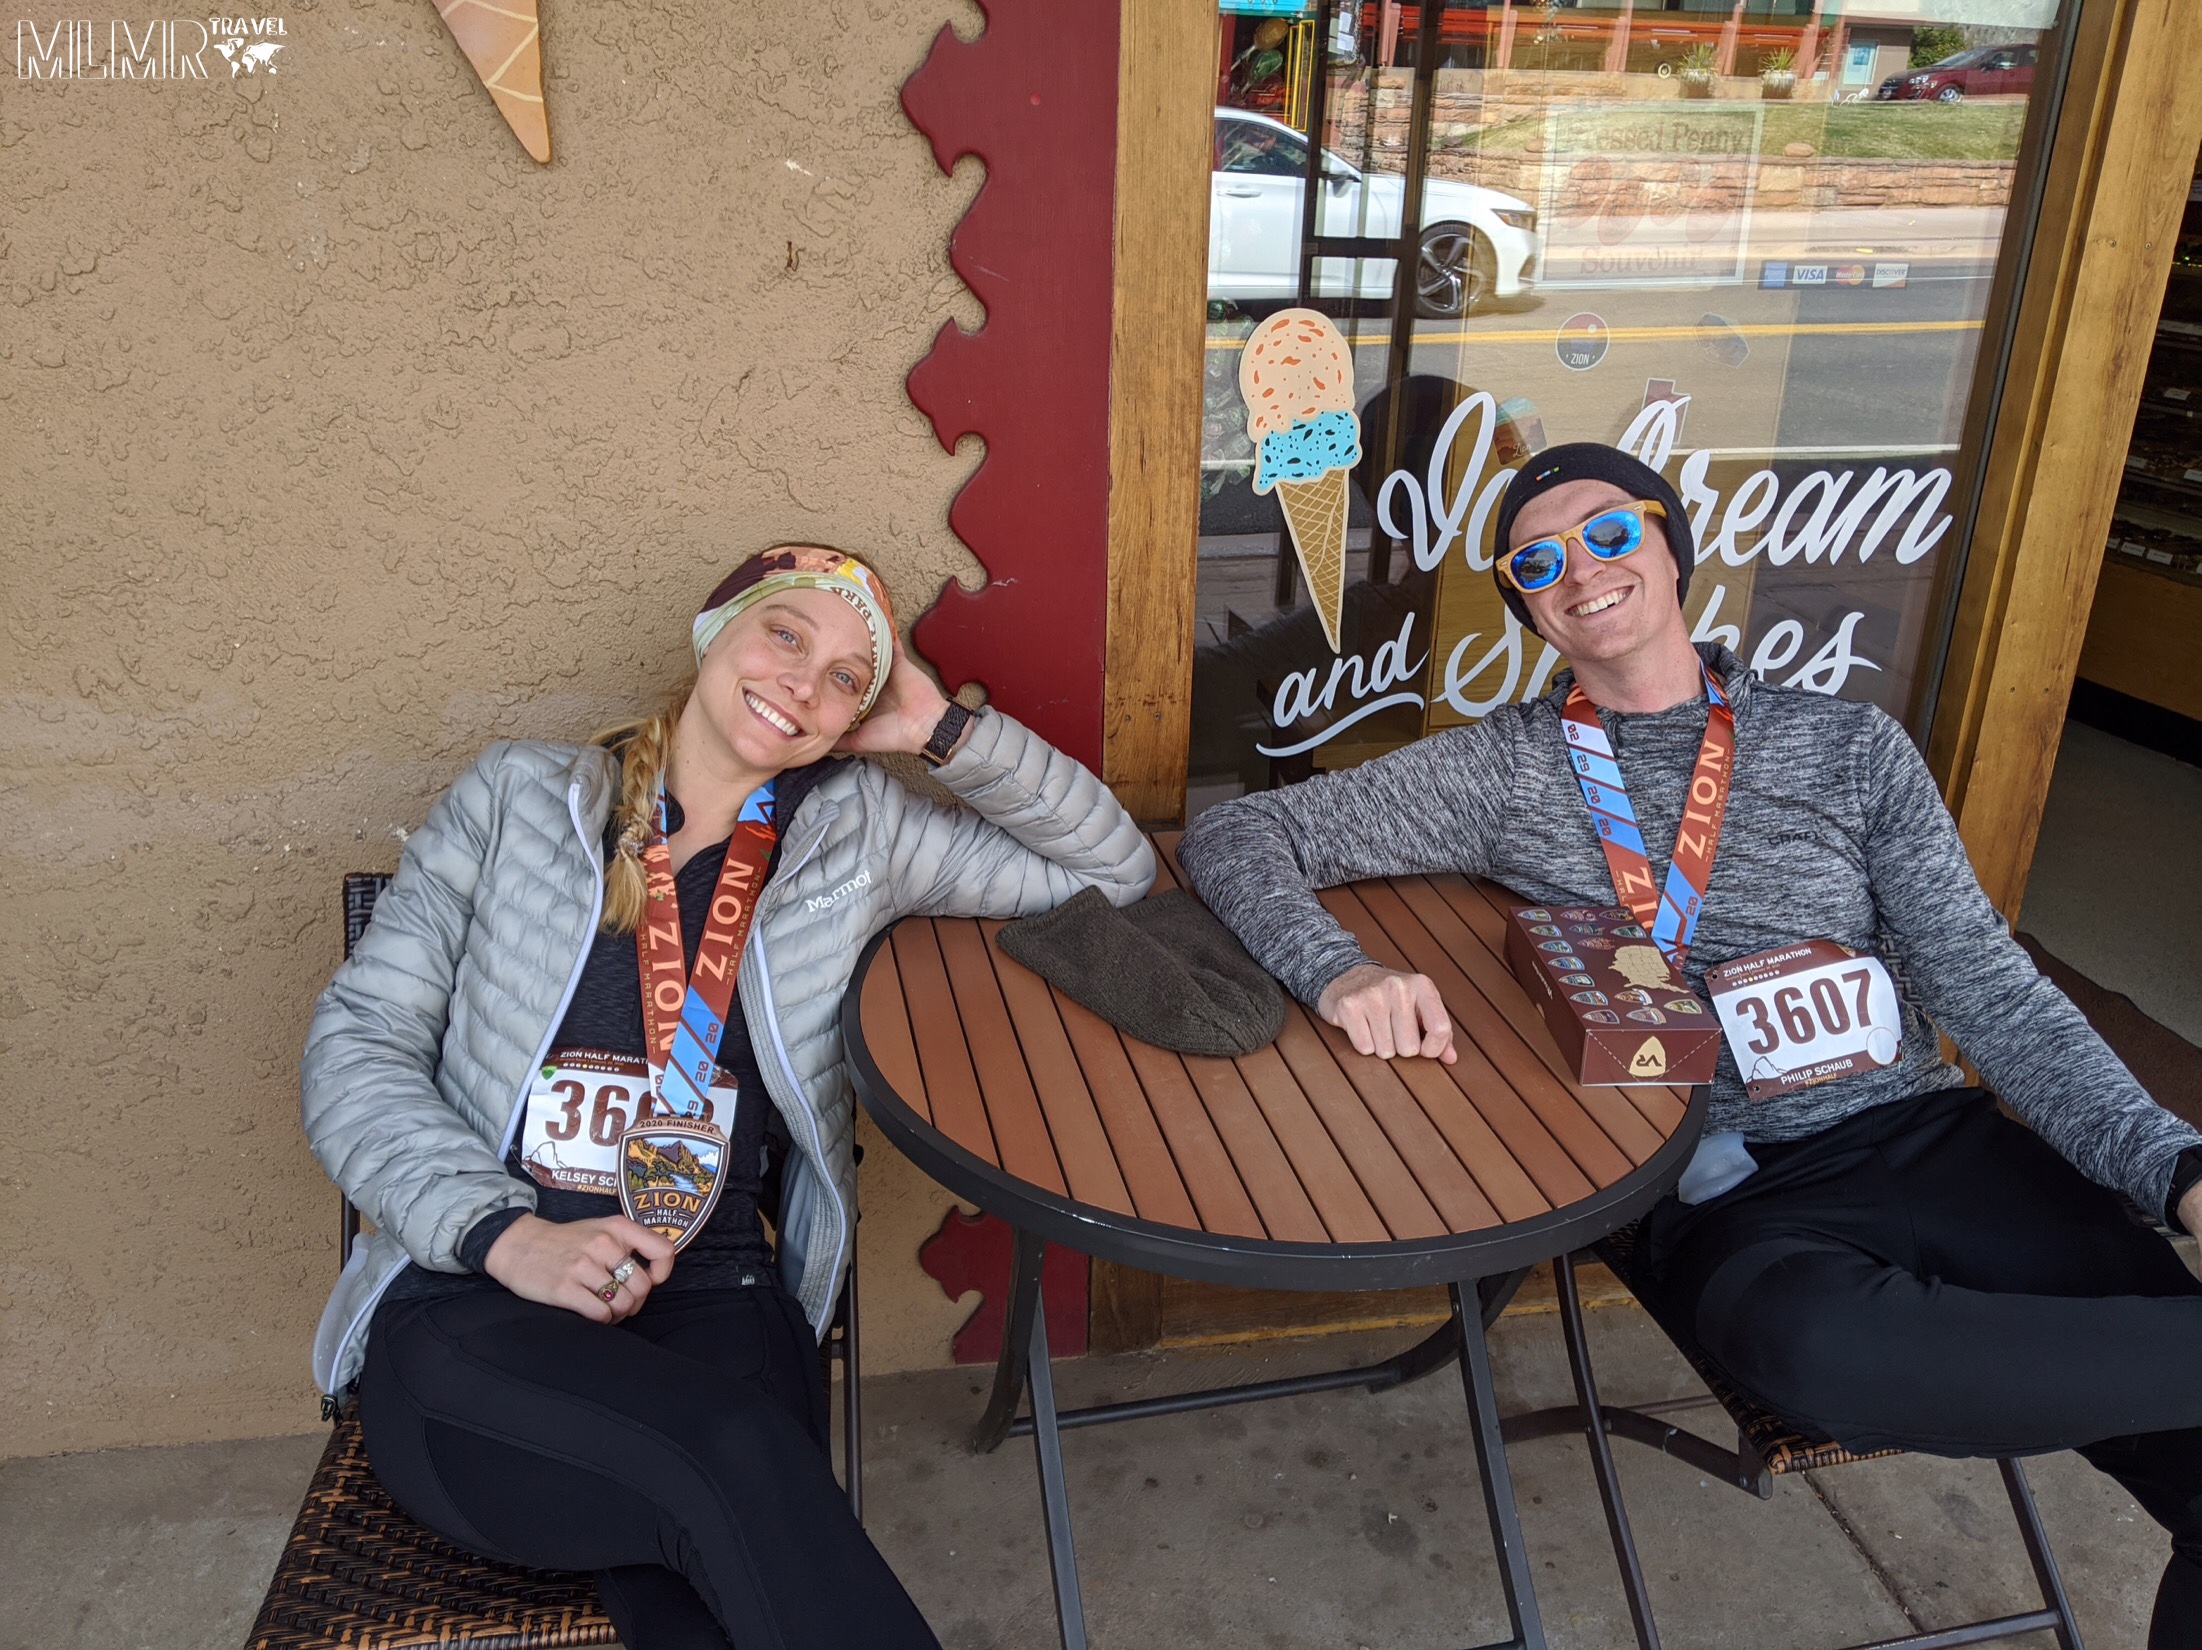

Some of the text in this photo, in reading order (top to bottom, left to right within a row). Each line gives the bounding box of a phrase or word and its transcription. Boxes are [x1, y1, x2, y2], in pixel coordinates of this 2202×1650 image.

[1795, 269, 1825, 280] VISA
[1571, 353, 1590, 365] ZION
[1377, 391, 1517, 572] Ic
[1273, 611, 1430, 728] and
[1567, 723, 1612, 837] 02 29 20 20
[1677, 739, 1725, 860] ZION
[1715, 755, 1731, 817] MARATHON
[805, 870, 872, 912] Marmot
[1685, 896, 1699, 916] 20
[695, 857, 755, 982] ZION
[728, 874, 761, 976] HALF MARATHON
[1723, 966, 1743, 977] ZION
[1744, 959, 1765, 972] HALF
[1767, 947, 1812, 965] MARATHON
[648, 922, 685, 1051] ZION
[644, 973, 656, 1044] MARATHON
[1735, 968, 1872, 1055] 3607
[560, 1051, 583, 1059] ZION
[584, 1052, 610, 1061] HALF
[695, 1061, 709, 1082] 20
[705, 1022, 719, 1044] 20
[1780, 1058, 1854, 1086] PHILIP SCHAUB
[545, 1079, 714, 1147] 36
[640, 1120, 714, 1134] 2020 FINISHER
[551, 1170, 617, 1187] KELSEY SC
[577, 1184, 617, 1194] #ZIONHALF
[633, 1191, 702, 1213] ZION
[643, 1217, 689, 1228] MARATHON
[656, 1208, 677, 1217] HALF
